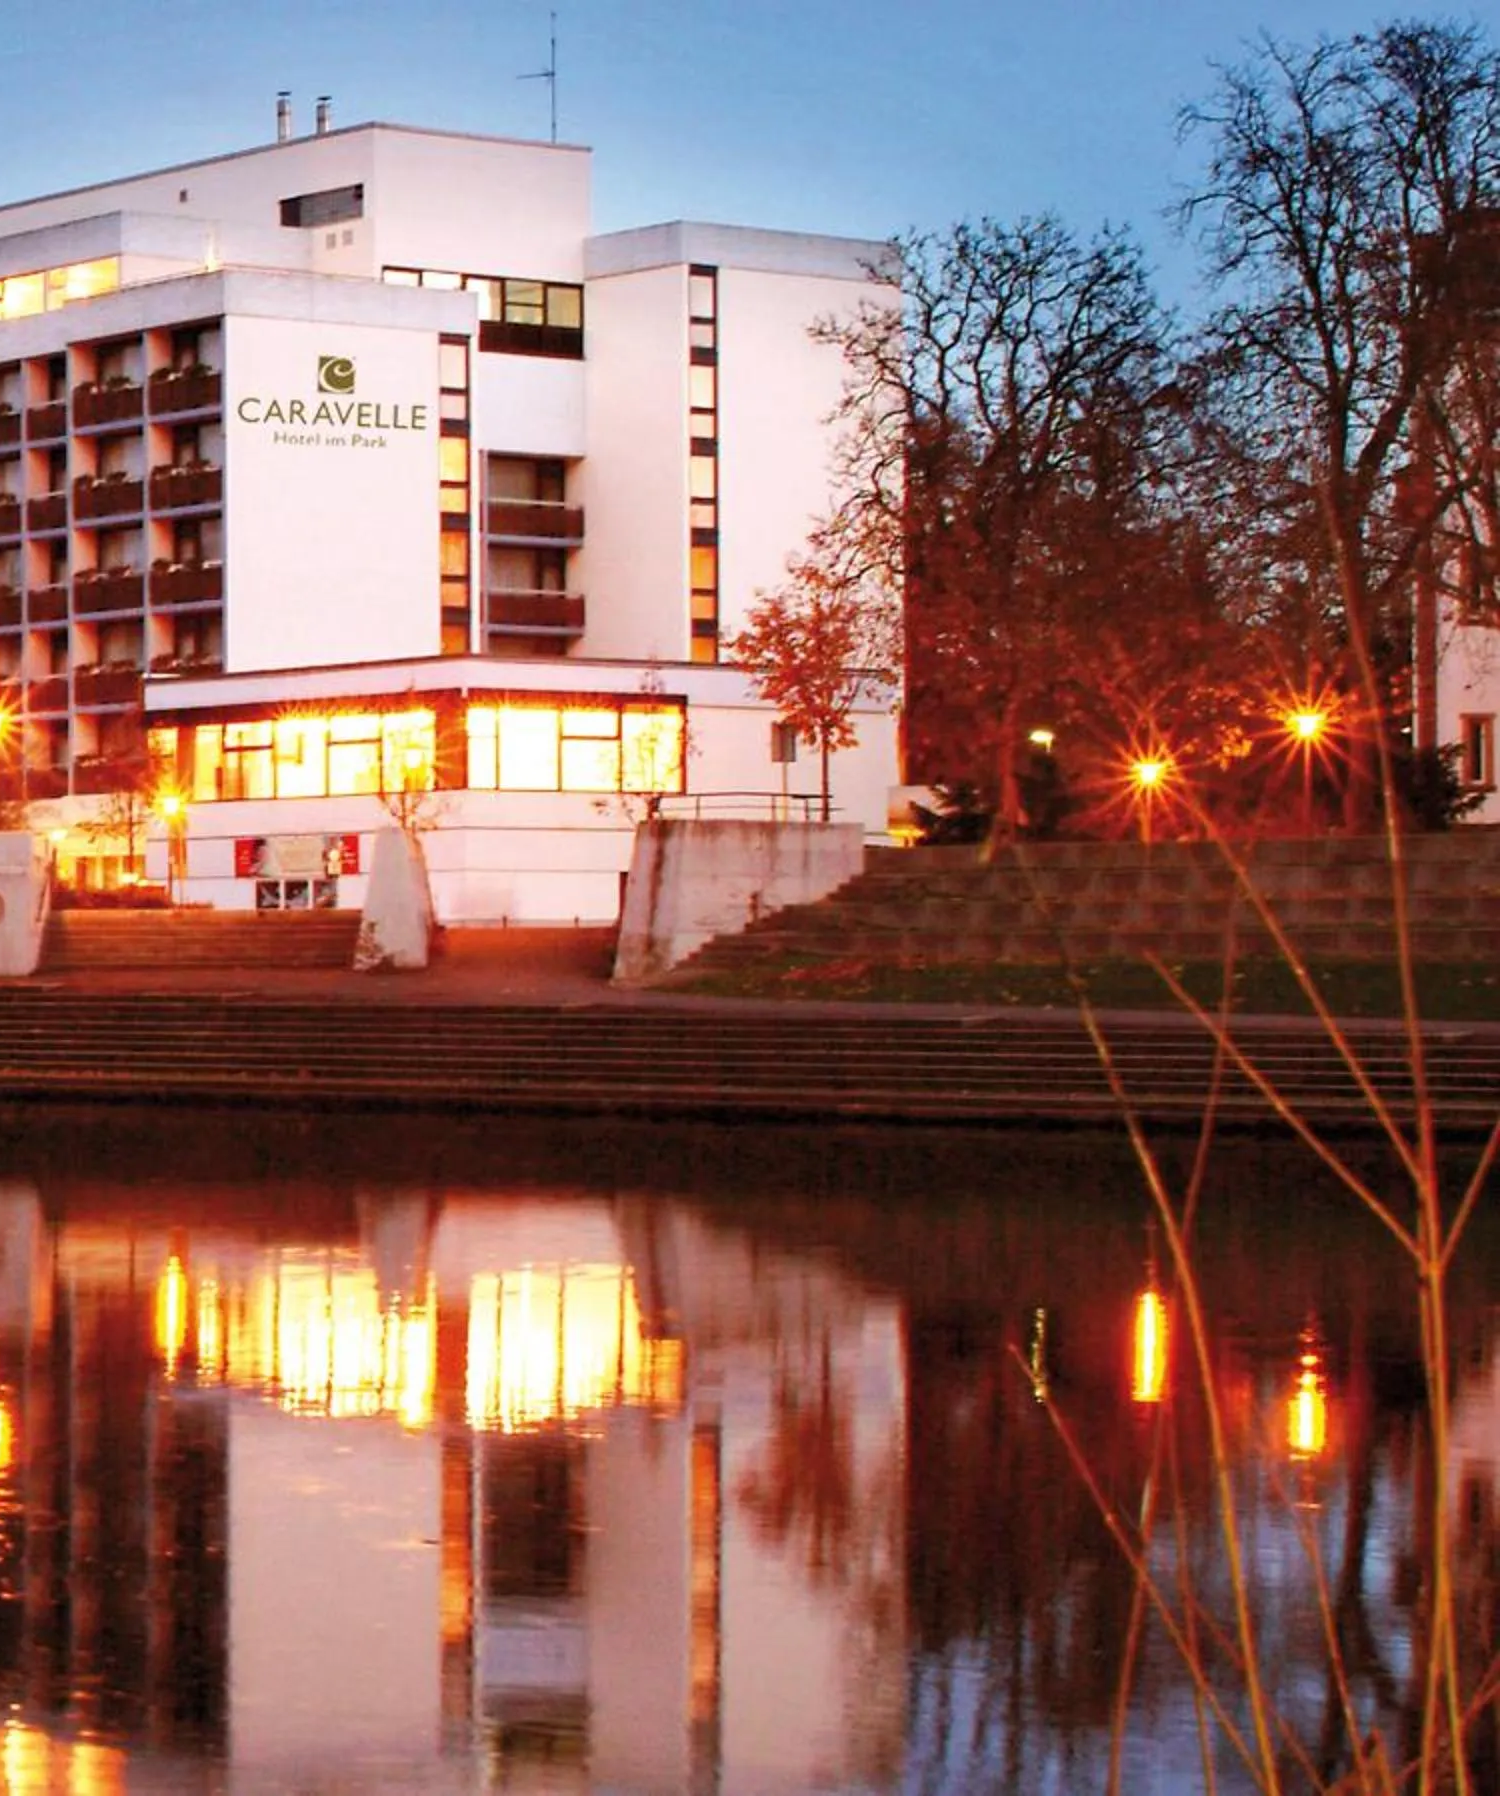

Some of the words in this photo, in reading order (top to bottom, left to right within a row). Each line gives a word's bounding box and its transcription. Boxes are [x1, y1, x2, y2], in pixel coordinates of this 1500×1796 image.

[237, 397, 428, 430] CARAVELLE
[273, 431, 320, 445] Hotel
[325, 433, 346, 446] im
[351, 433, 388, 449] Park
